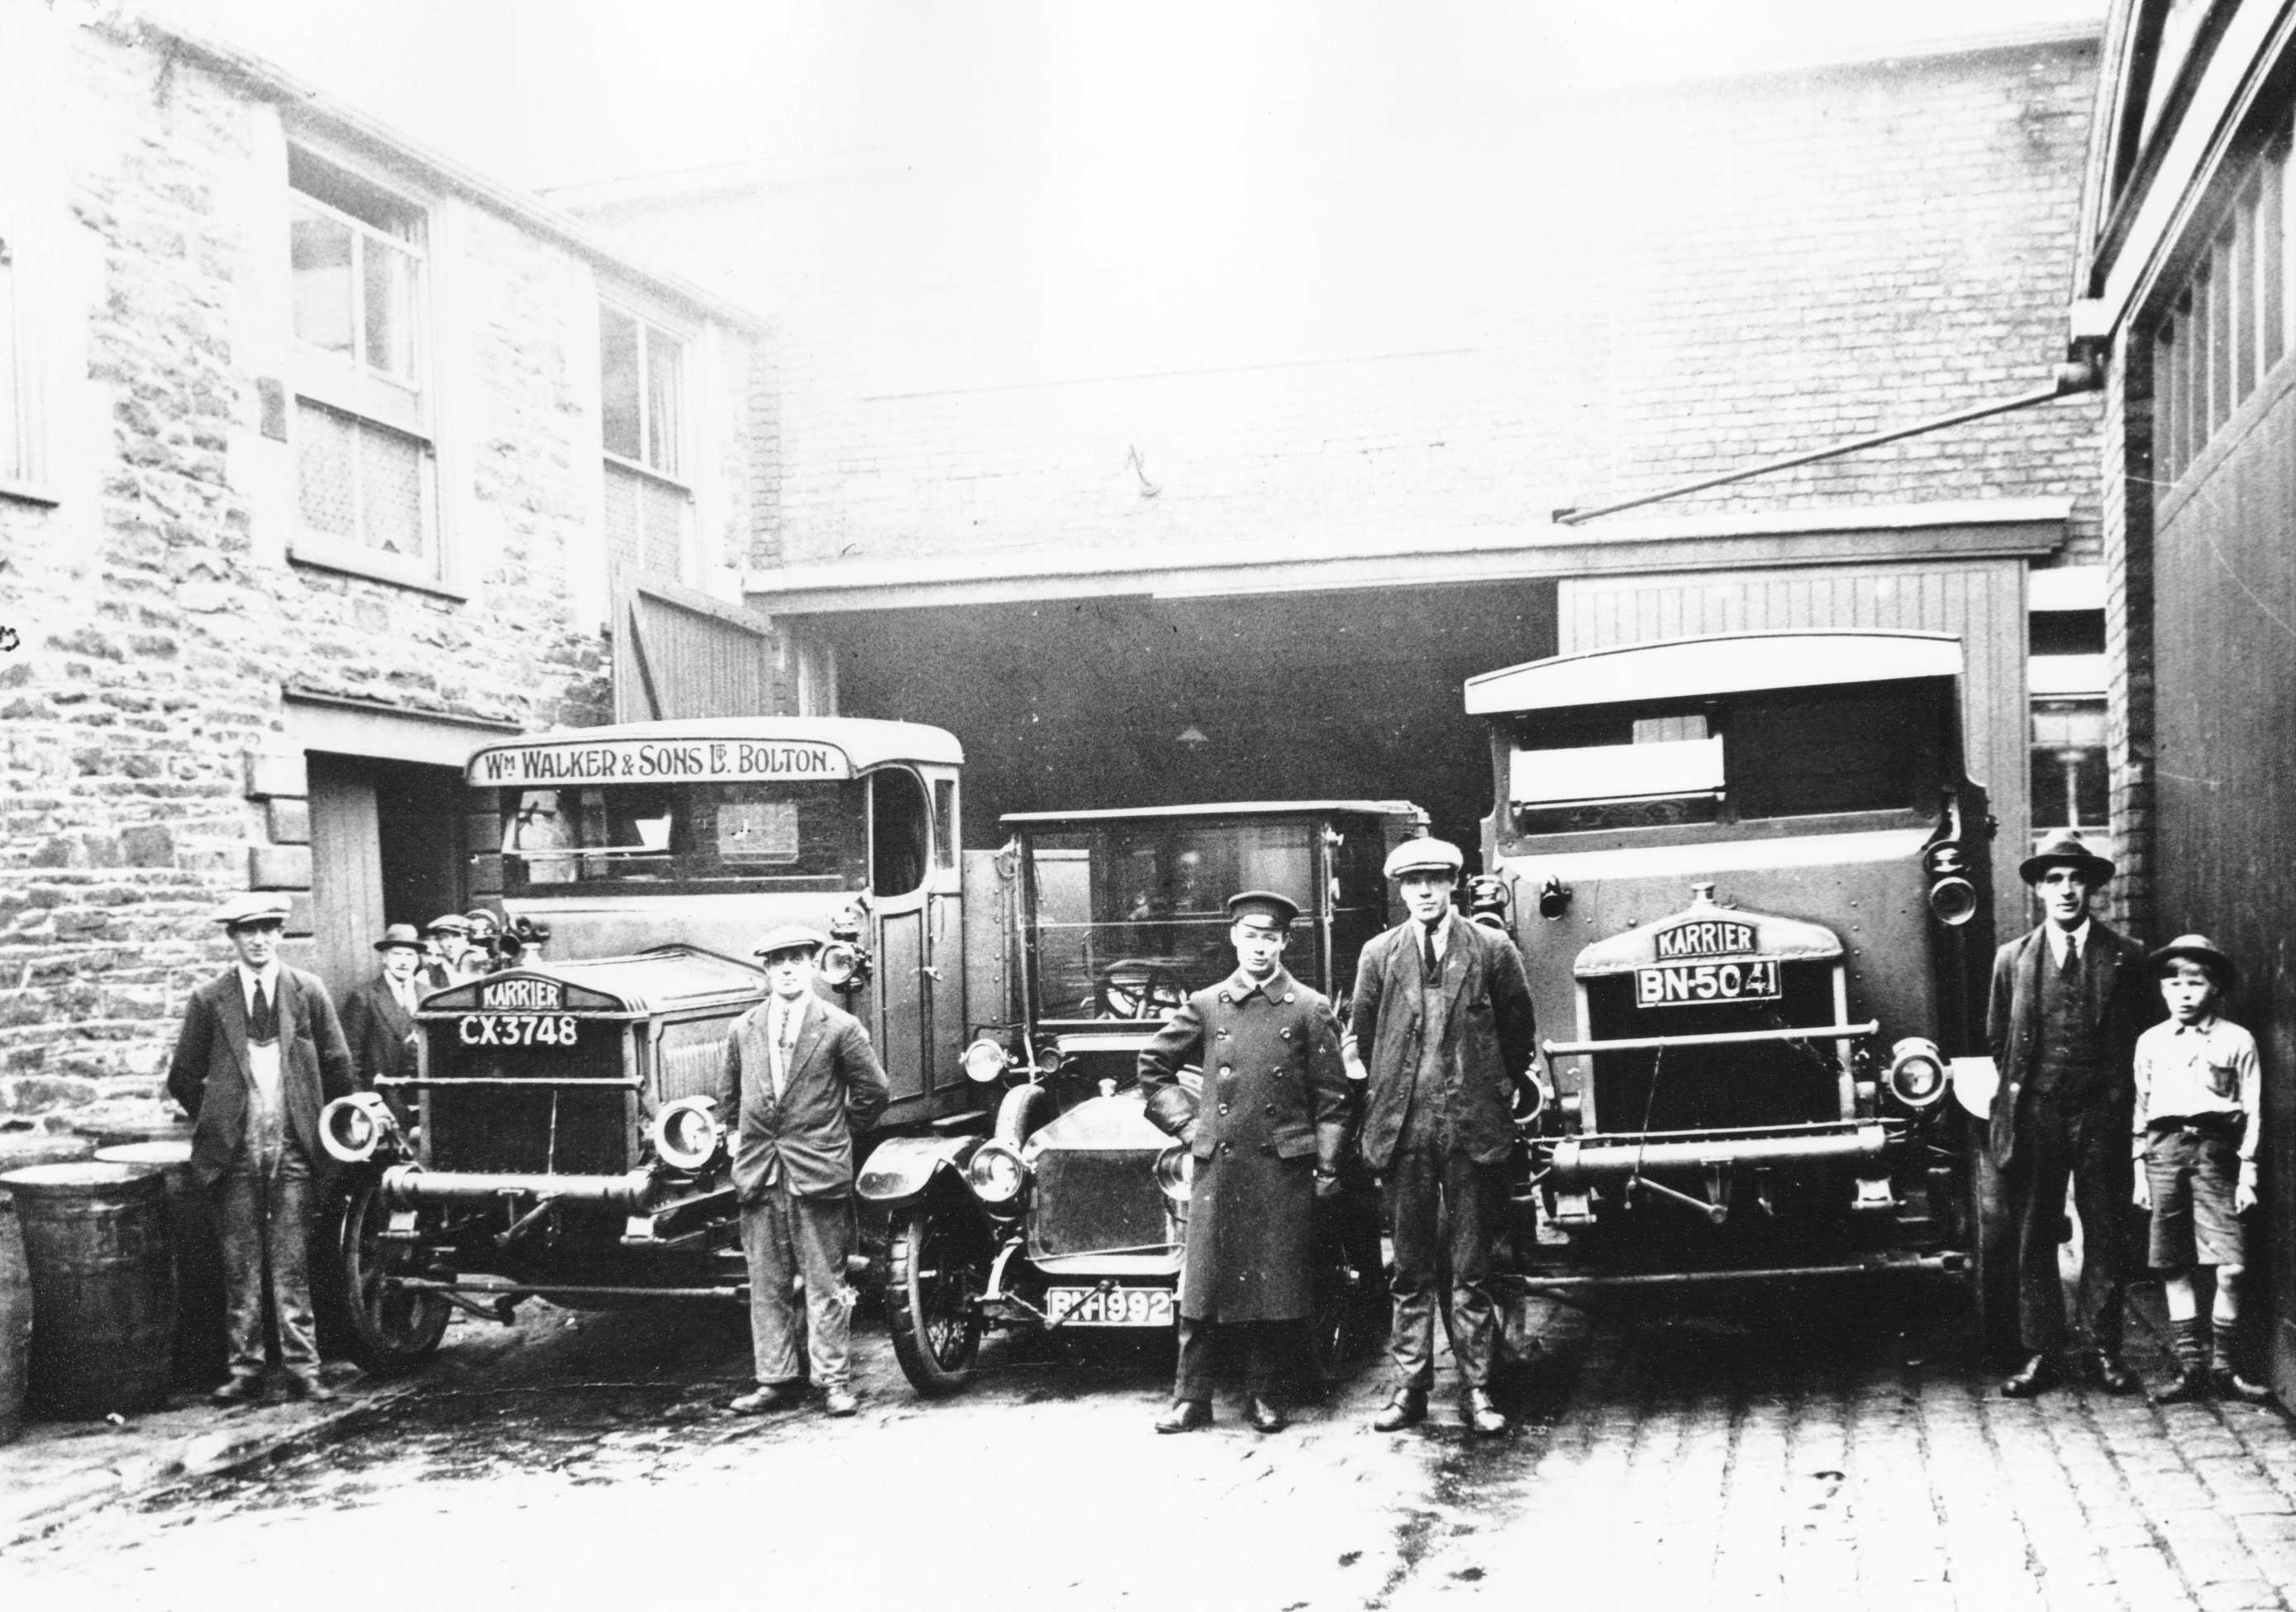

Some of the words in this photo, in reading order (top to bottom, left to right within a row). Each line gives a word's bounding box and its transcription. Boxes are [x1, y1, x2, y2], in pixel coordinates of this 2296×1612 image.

[522, 750, 617, 778] WALKER
[622, 754, 635, 775] &
[639, 745, 703, 775] SONS
[739, 744, 835, 773] BOLTON.
[1660, 924, 1751, 955] KARRIER
[483, 980, 558, 1006] KARRIER
